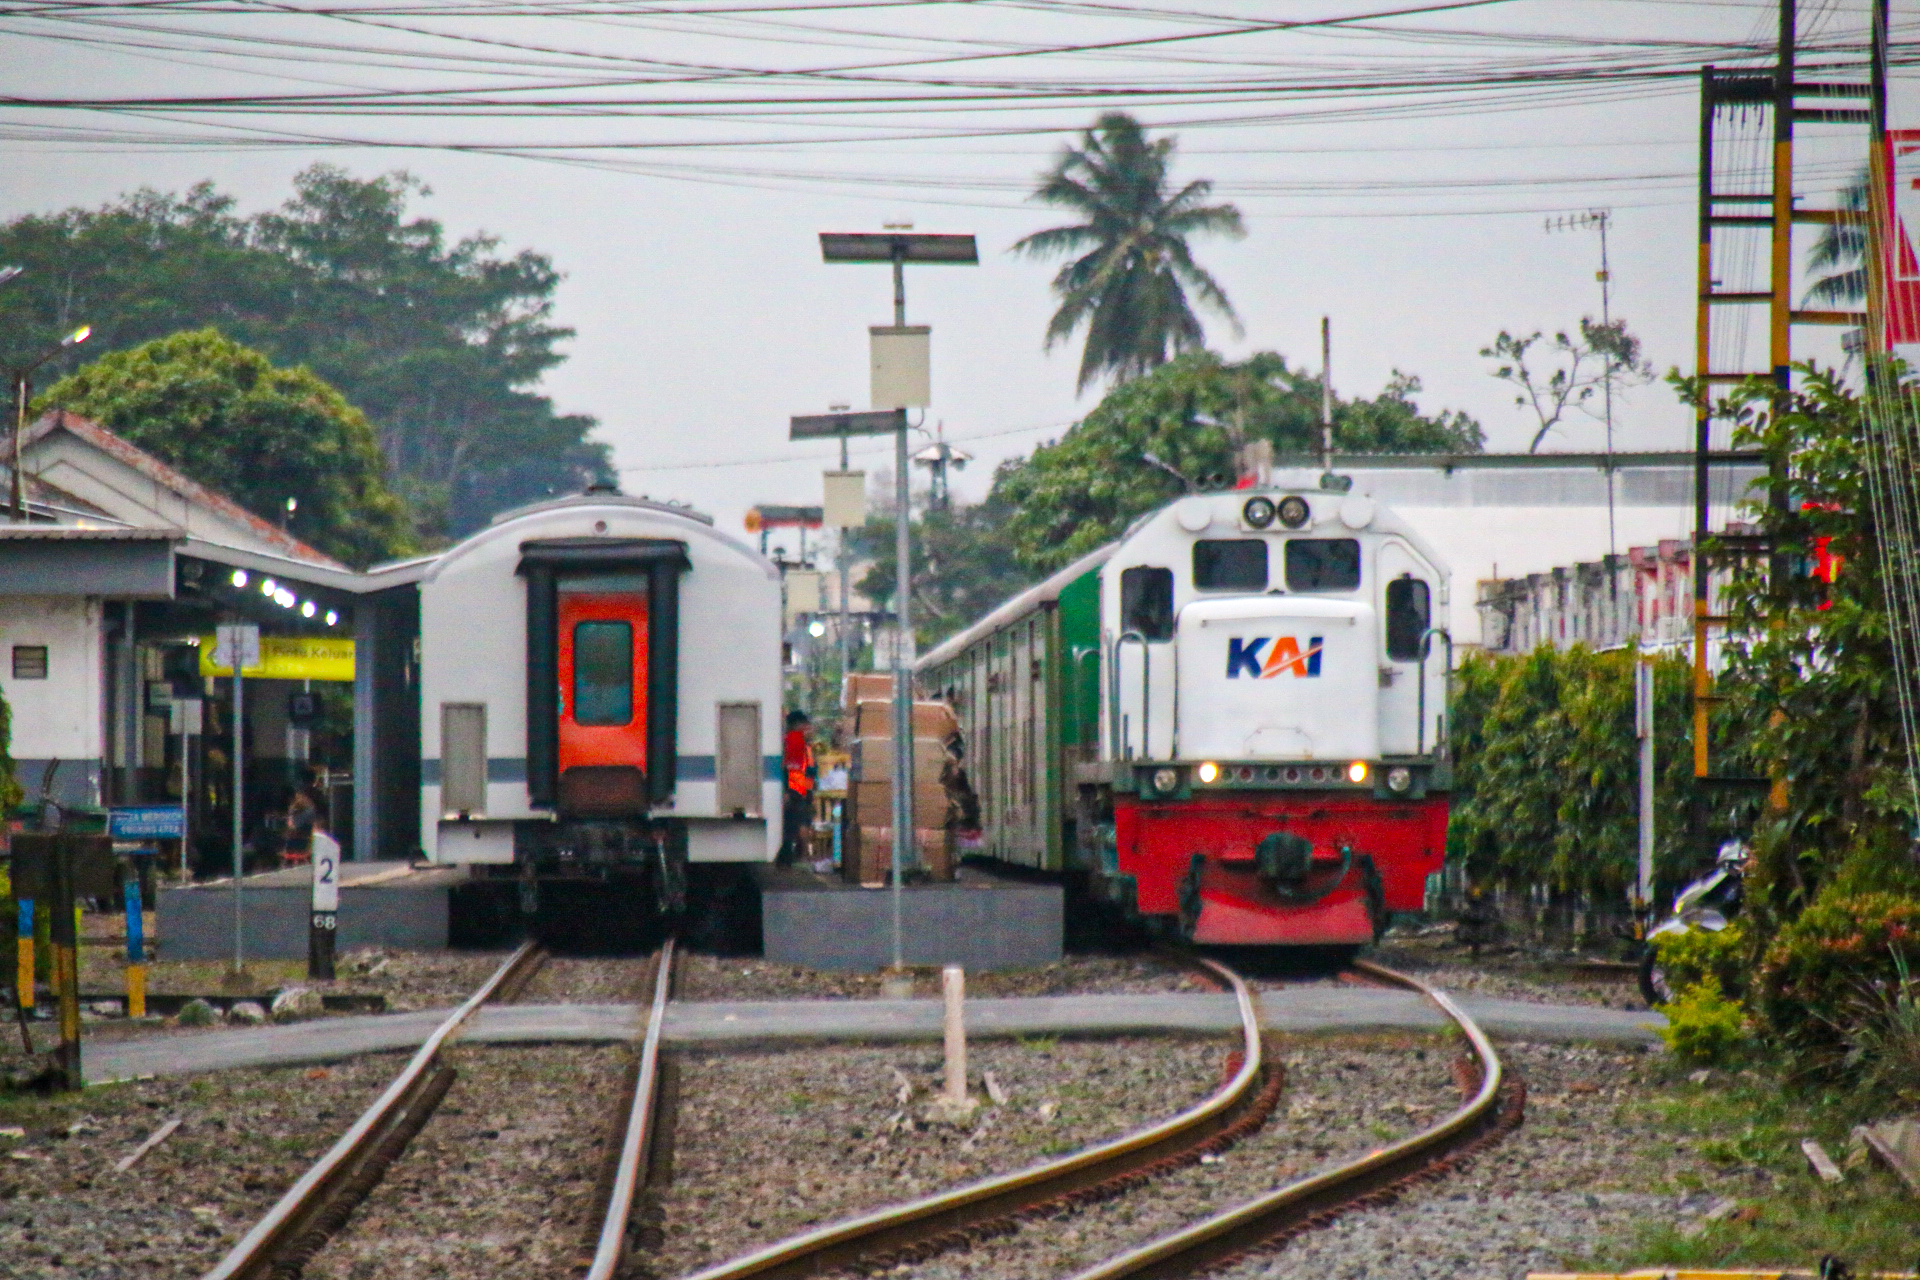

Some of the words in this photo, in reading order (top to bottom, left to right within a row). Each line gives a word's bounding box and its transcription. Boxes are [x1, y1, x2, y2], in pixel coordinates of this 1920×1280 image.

[1226, 636, 1324, 679] KAI
[320, 858, 333, 884] 2
[313, 915, 337, 930] 68
